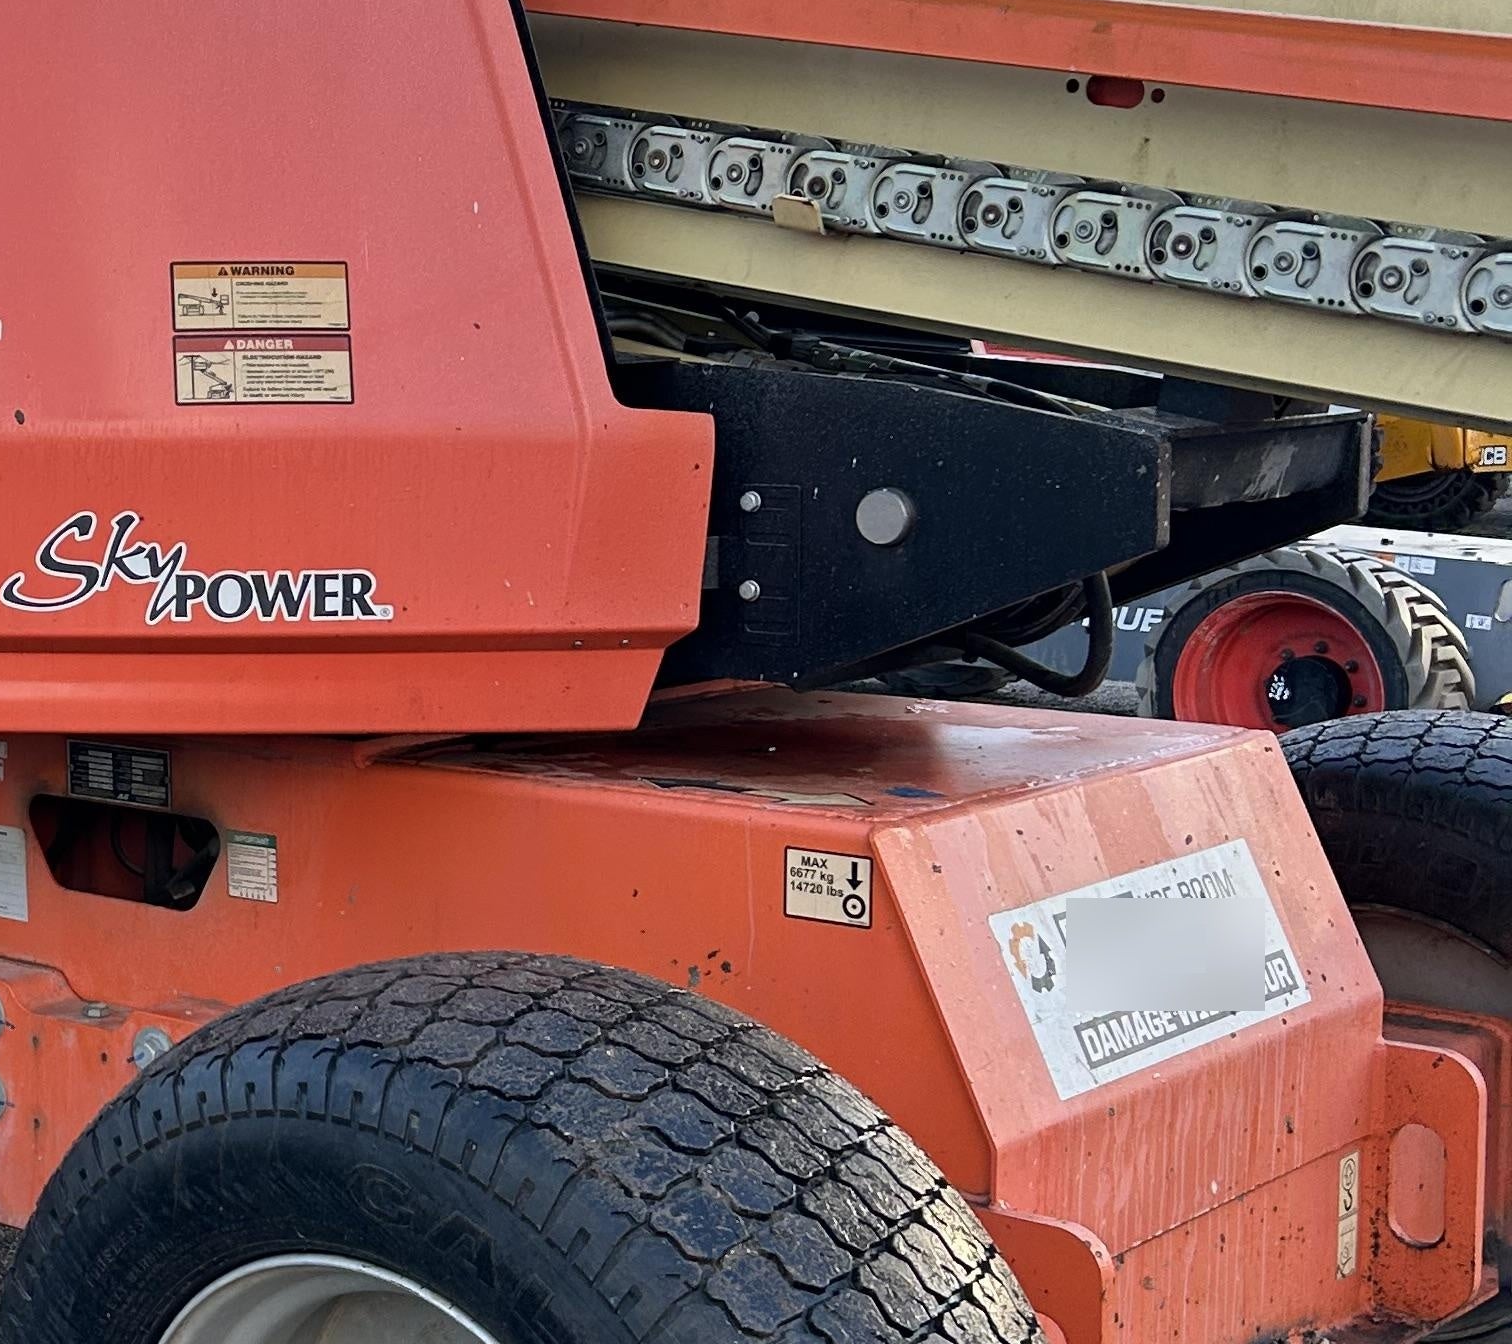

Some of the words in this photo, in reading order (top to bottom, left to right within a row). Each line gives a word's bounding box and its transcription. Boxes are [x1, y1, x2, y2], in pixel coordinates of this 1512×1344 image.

[230, 266, 295, 276] WARNING
[236, 339, 294, 350] DANGER
[2, 514, 183, 622] Sky
[175, 573, 377, 618] POWER
[801, 856, 828, 869] MAX
[790, 866, 816, 879] 6677
[820, 871, 834, 884] kg
[790, 880, 823, 895] 14720
[826, 885, 844, 897] lbs
[1080, 1010, 1178, 1063] DAMAGE
